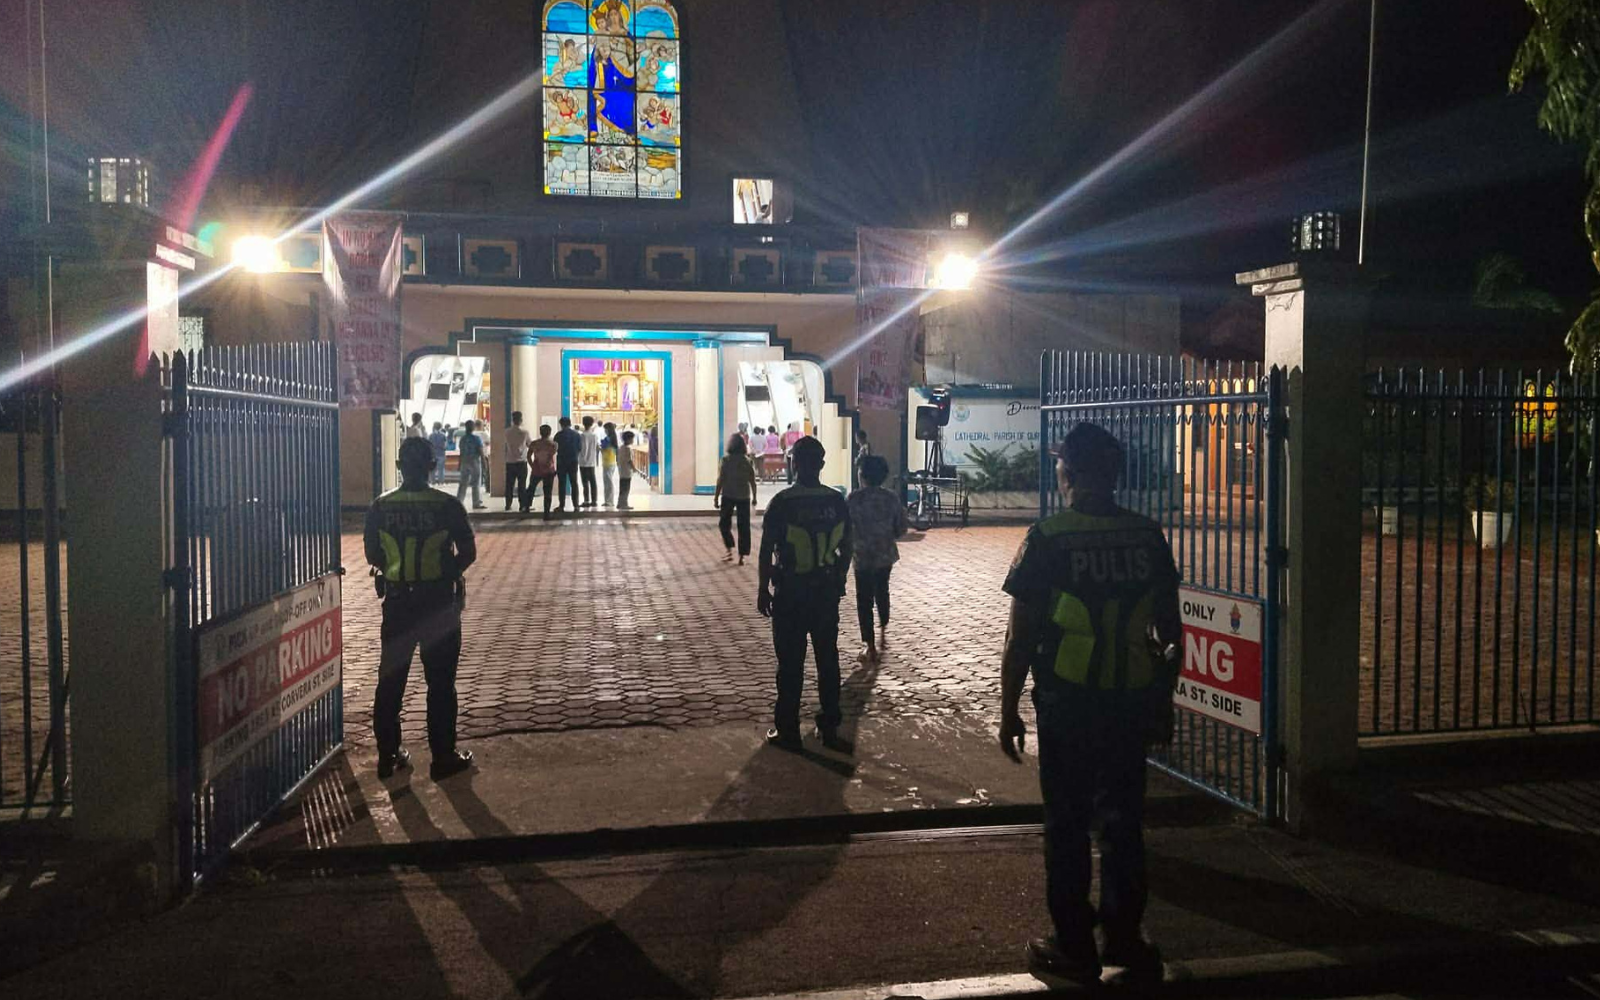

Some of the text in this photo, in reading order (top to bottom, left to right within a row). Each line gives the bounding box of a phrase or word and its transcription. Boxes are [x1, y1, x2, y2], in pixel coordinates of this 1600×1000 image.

[955, 432, 990, 441] CATHEDRAL
[994, 432, 1015, 441] PARISH
[1017, 432, 1024, 441] OF
[1071, 548, 1152, 582] PULIS
[1183, 601, 1215, 621] ONLY
[219, 618, 332, 722] NO PARKING
[1184, 632, 1234, 682] NG
[281, 681, 311, 708] CORVERA
[1190, 686, 1208, 705] ST.
[1212, 693, 1242, 716] SIDE
